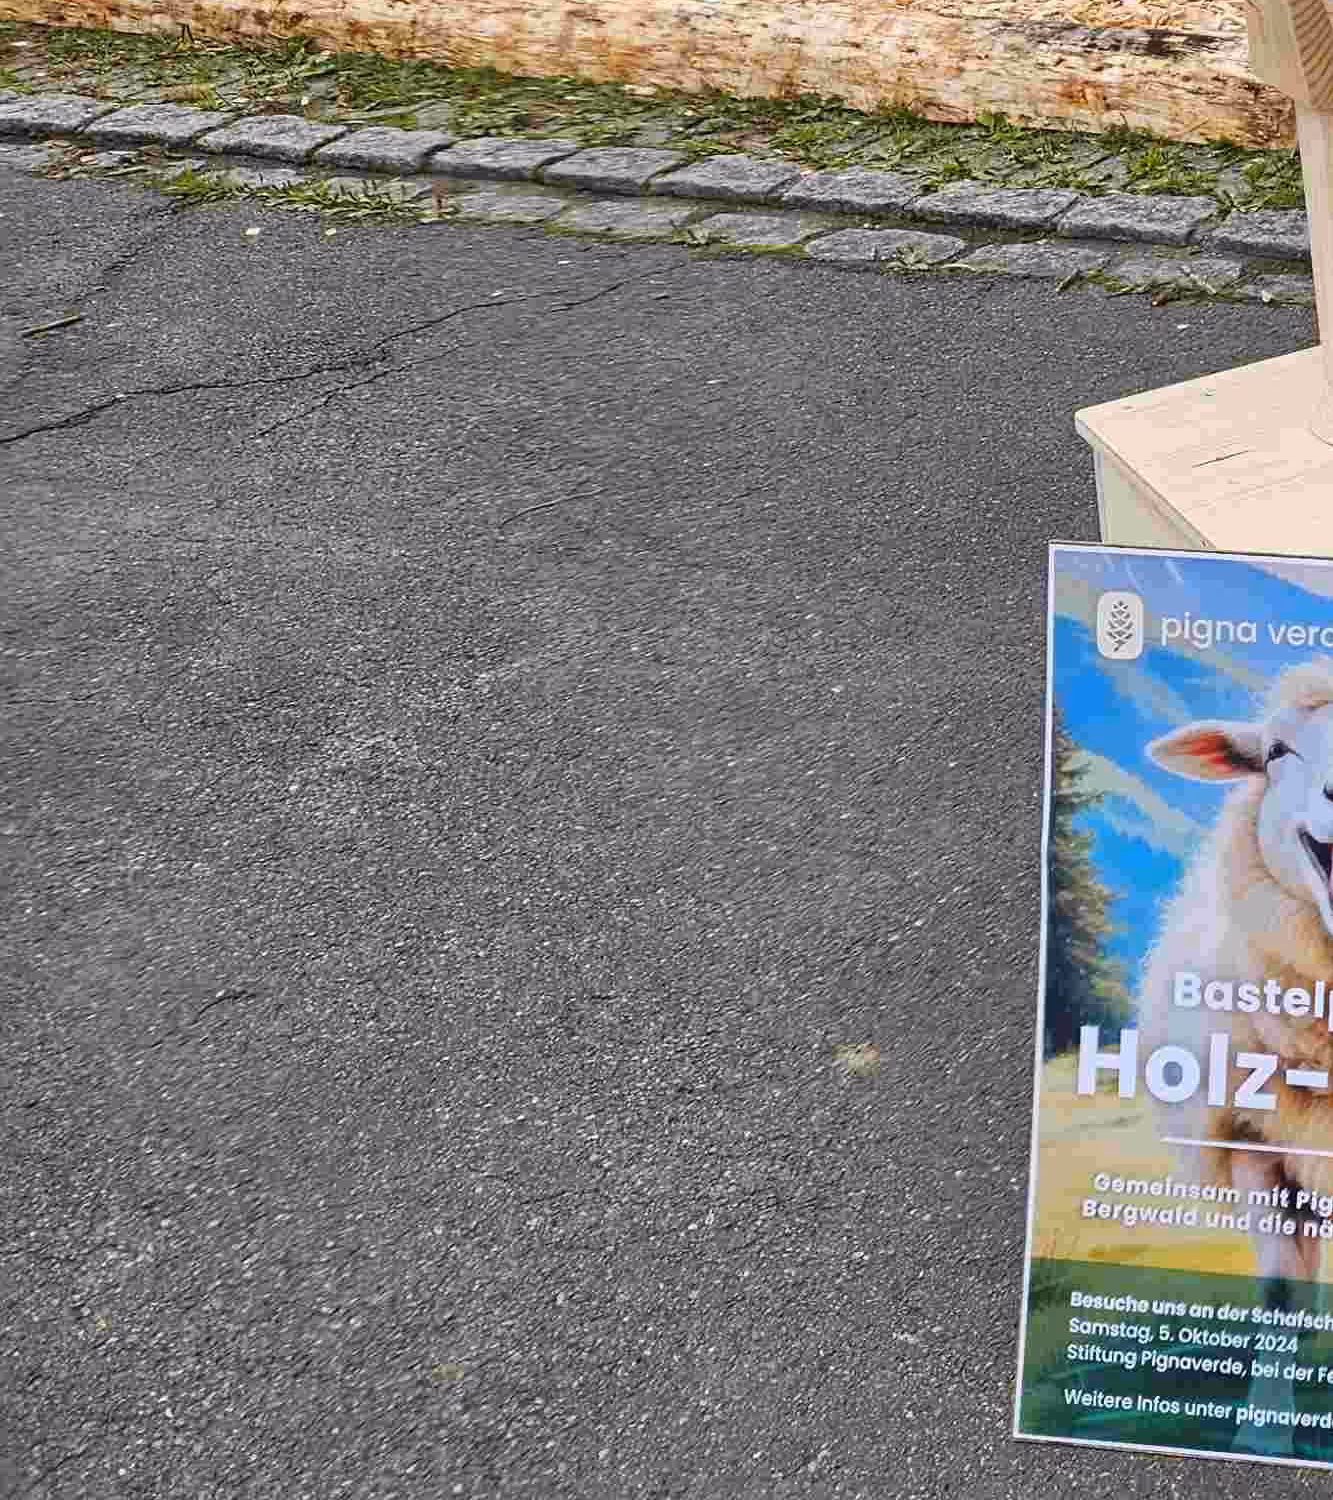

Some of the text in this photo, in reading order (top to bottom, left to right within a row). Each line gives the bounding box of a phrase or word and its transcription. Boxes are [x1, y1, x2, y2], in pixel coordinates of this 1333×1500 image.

[1160, 611, 1258, 649] pigna
[1093, 1171, 1241, 1204] Gemeinsam
[1247, 1185, 1290, 1208] mit
[1080, 1198, 1199, 1227] Bergwald
[1205, 1211, 1251, 1232] und
[1258, 1211, 1297, 1236] die
[1070, 1291, 1149, 1313] Besuche
[1151, 1300, 1186, 1318] uns
[1188, 1305, 1214, 1319] an
[1216, 1302, 1249, 1322] der
[1068, 1316, 1298, 1353] Samstag, 5. Oktober 2024
[1066, 1344, 1137, 1369] Stiftung
[1140, 1349, 1248, 1378] Pignaverde,
[1250, 1359, 1280, 1378] bei
[1282, 1362, 1314, 1383] der
[1063, 1388, 1135, 1411] Weitere
[1136, 1394, 1180, 1414] Infos
[1184, 1401, 1232, 1419] unter
